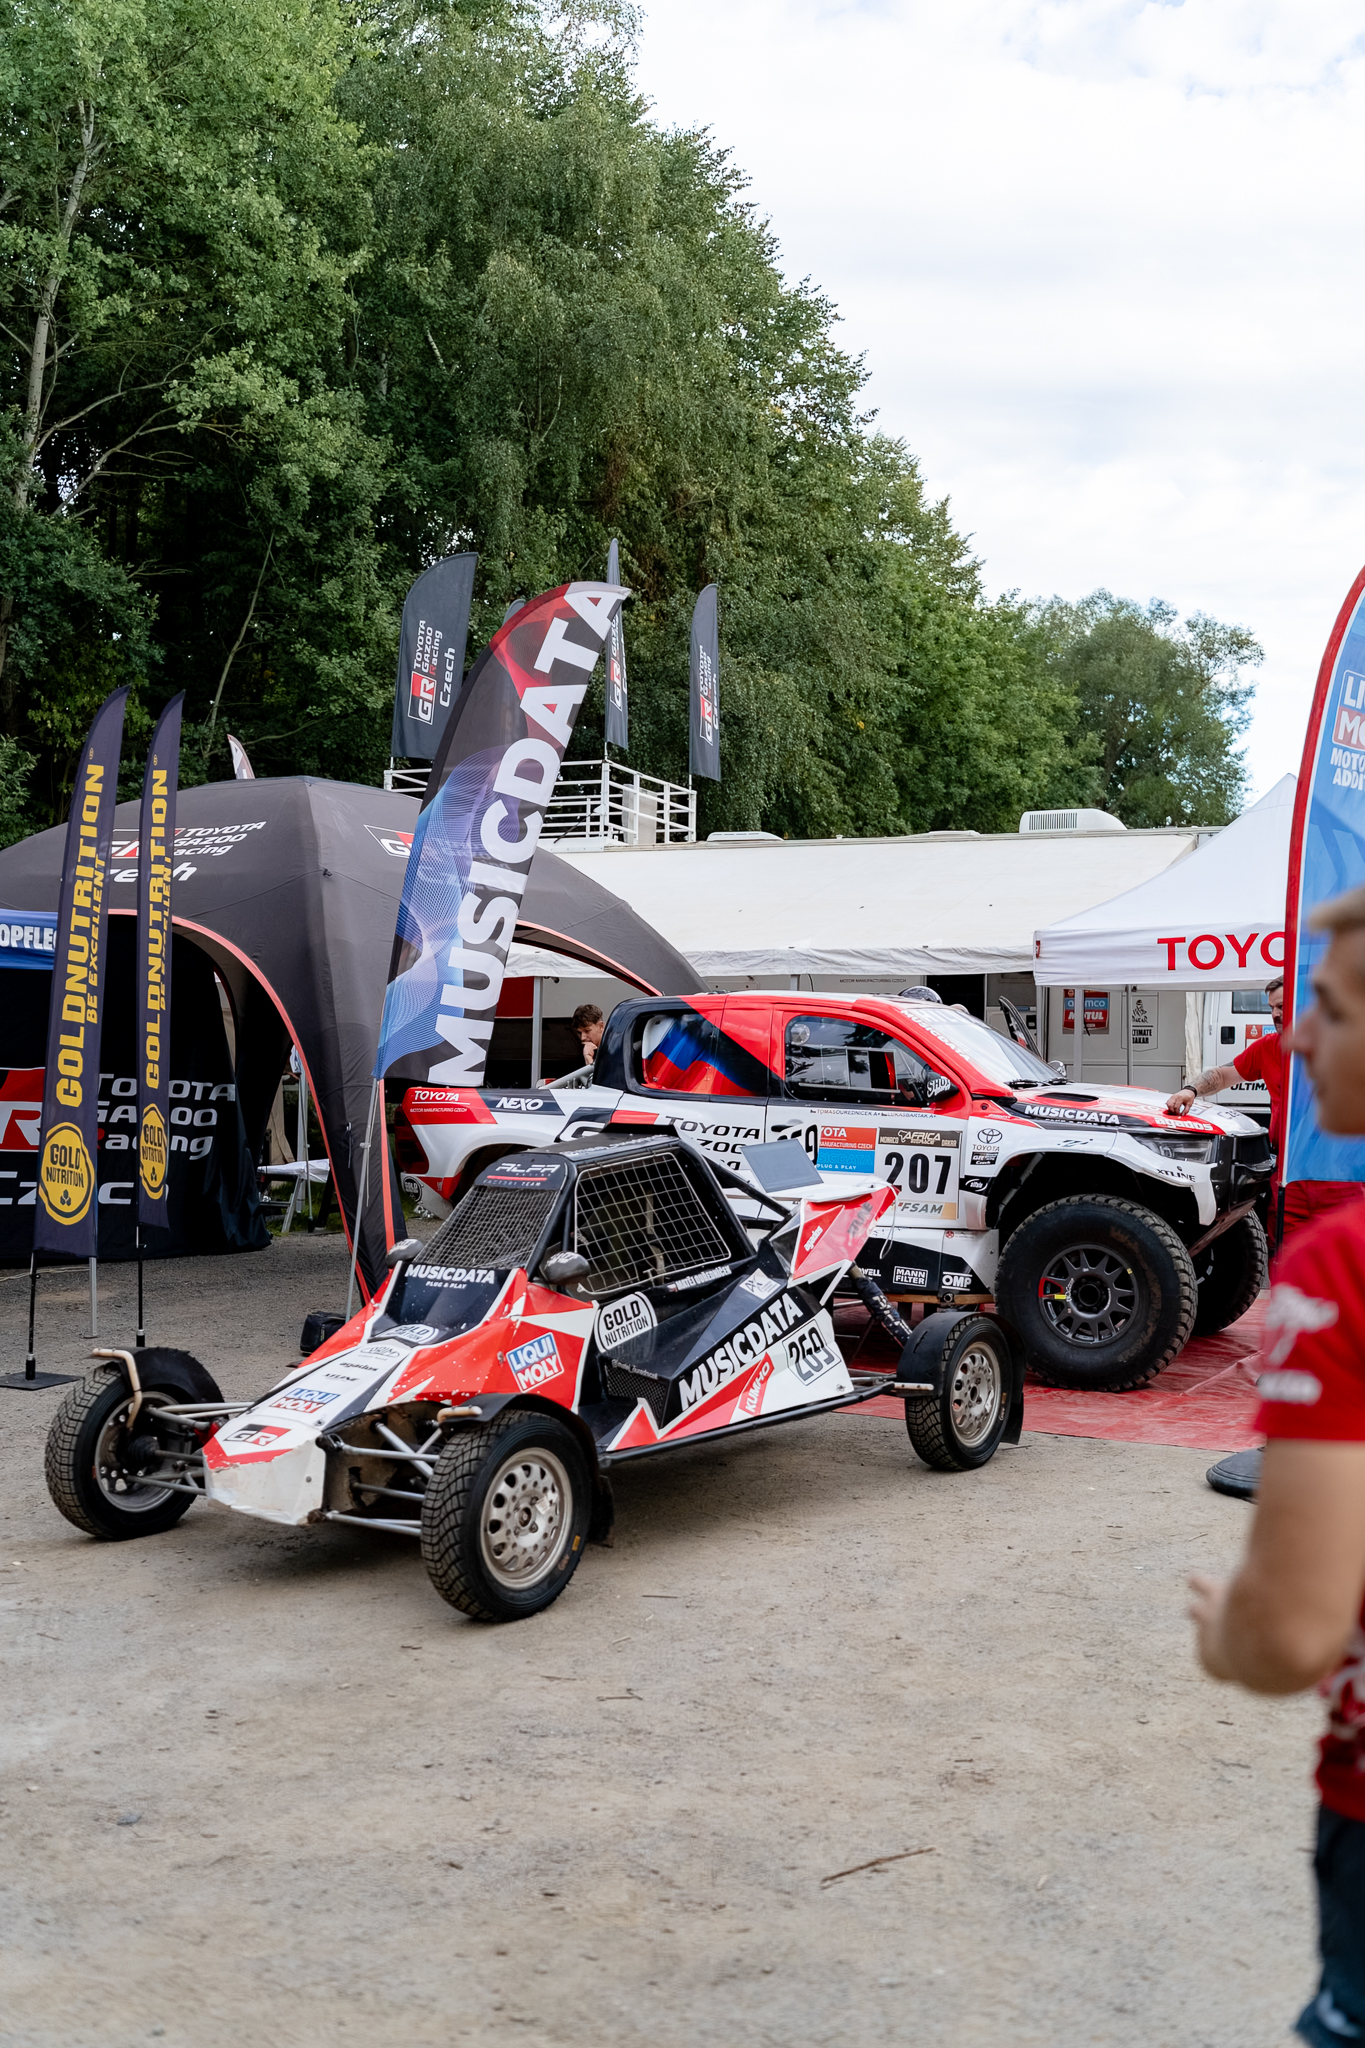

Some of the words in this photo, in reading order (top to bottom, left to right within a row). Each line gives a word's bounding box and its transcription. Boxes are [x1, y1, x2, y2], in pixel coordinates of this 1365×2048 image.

[413, 620, 426, 669] TOYOTA
[421, 627, 433, 673] GAZOO
[429, 630, 443, 675] Racing
[440, 647, 456, 708] Czech
[418, 678, 436, 721] GR
[1343, 675, 1365, 710] LI
[184, 821, 267, 838] TOYOTA
[428, 582, 630, 1088] MUSICDATA
[174, 845, 234, 857] acing
[88, 854, 106, 987] EXCELLENT
[145, 769, 168, 1089] GOLDNUTRITION
[0, 923, 57, 950] OPFLE
[56, 764, 105, 1108] GOLDNUTRITION
[86, 993, 99, 1024] BE
[900, 1010, 971, 1062] MUSICDATA
[97, 1073, 236, 1101] TOOTA
[414, 1090, 460, 1102] TOYOTA
[495, 1096, 544, 1111] NEXO
[1024, 1105, 1120, 1125] MUSICDATA
[143, 1123, 164, 1148] GOLD
[665, 1115, 760, 1139] TOYOTA
[903, 1131, 941, 1141] AFRICA
[1154, 1117, 1214, 1132] agados
[49, 1142, 81, 1169] GOLD
[818, 1152, 874, 1166] SICDATA
[972, 1143, 1000, 1151] TOYOTA
[45, 1165, 85, 1189] NUTRITION
[495, 1162, 561, 1173] ALFA
[884, 1152, 951, 1195] 207
[1157, 1168, 1196, 1183] XTLINE
[901, 1202, 943, 1214] FSAM
[803, 1225, 823, 1252] agados
[404, 1263, 496, 1284] MUSICDATA
[895, 1275, 925, 1285] FILTER
[896, 1268, 926, 1278] MANN
[942, 1274, 972, 1288] OMP
[603, 1300, 642, 1331] GOLD
[604, 1316, 649, 1346] NUTRITION
[509, 1335, 555, 1372] LIQUI
[678, 1292, 803, 1412] MUSICDATA
[516, 1354, 560, 1389] MOLY
[286, 1388, 339, 1404] LIQUI
[745, 1361, 770, 1413] KUMHO
[269, 1397, 325, 1413] MOLY
[228, 1429, 279, 1446] GR
